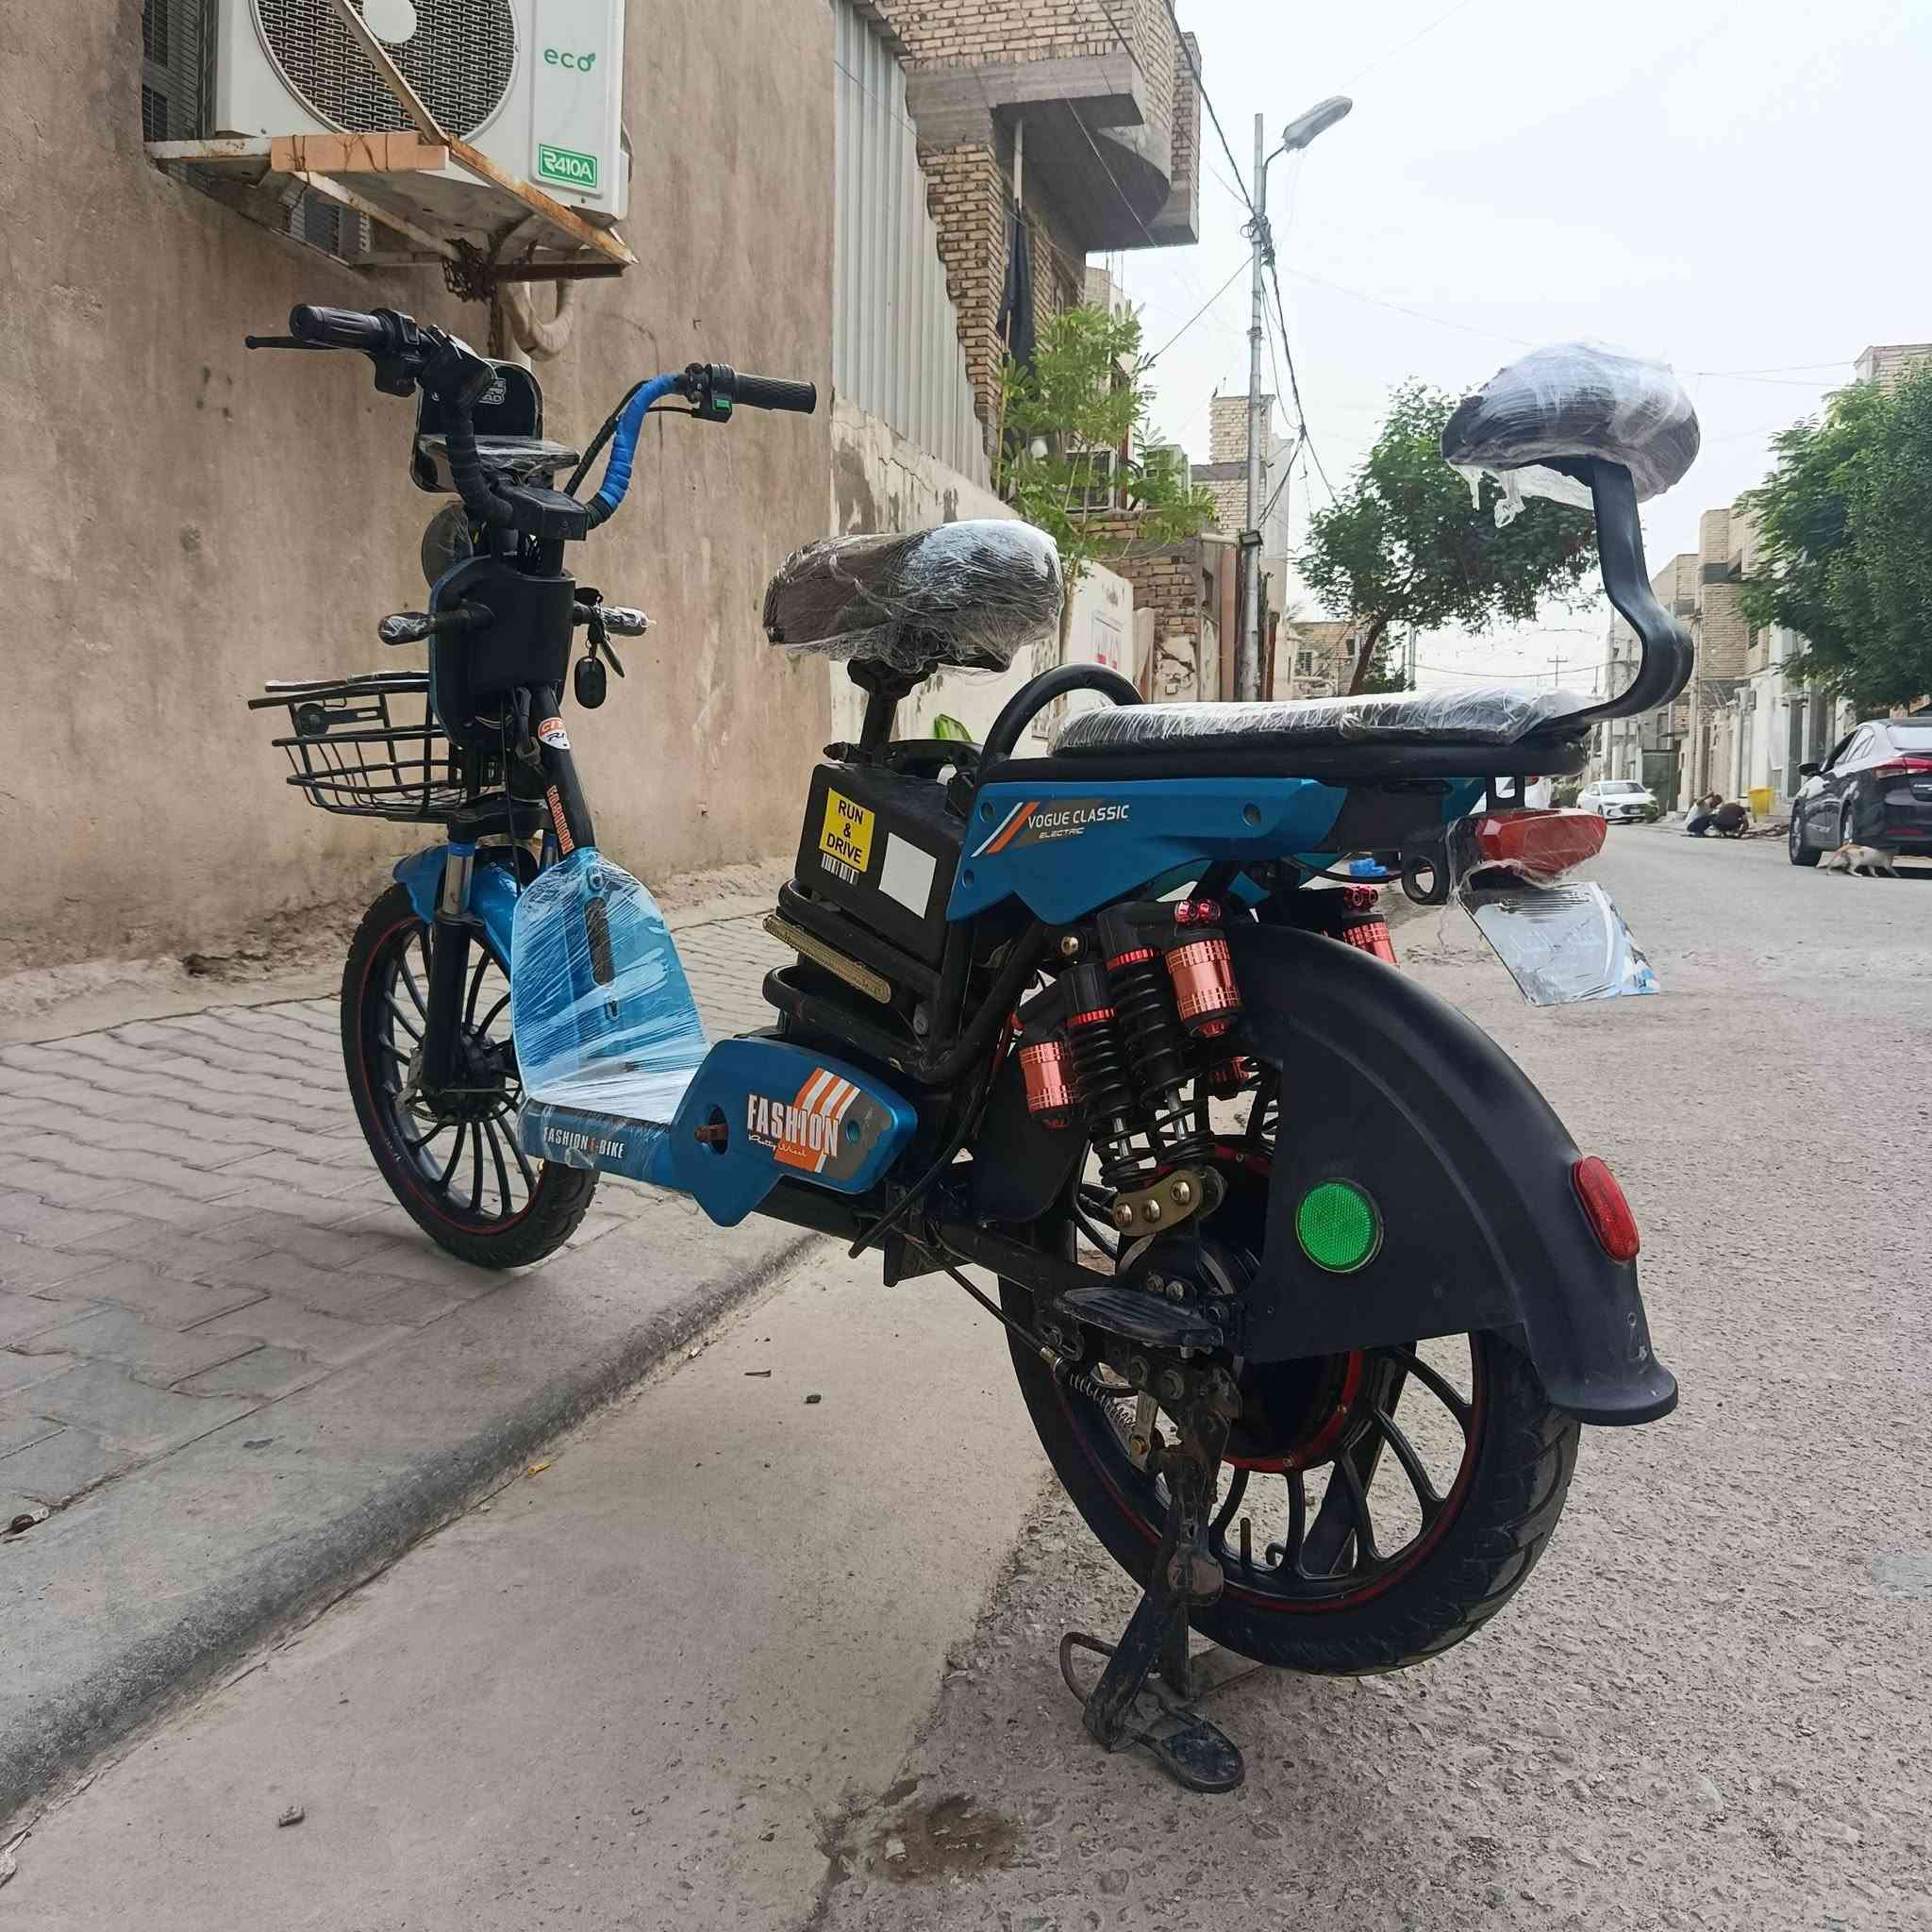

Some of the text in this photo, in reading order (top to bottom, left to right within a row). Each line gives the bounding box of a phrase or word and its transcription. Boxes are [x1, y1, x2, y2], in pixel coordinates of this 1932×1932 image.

[544, 48, 595, 73] eco
[542, 150, 593, 180] R410A
[838, 800, 863, 824] RUN
[1027, 805, 1130, 830] VOGUE CLASSIC
[843, 823, 852, 839] &
[826, 832, 863, 864] DRIVE
[747, 1093, 839, 1157] FASHION
[543, 1126, 590, 1151] FASHION
